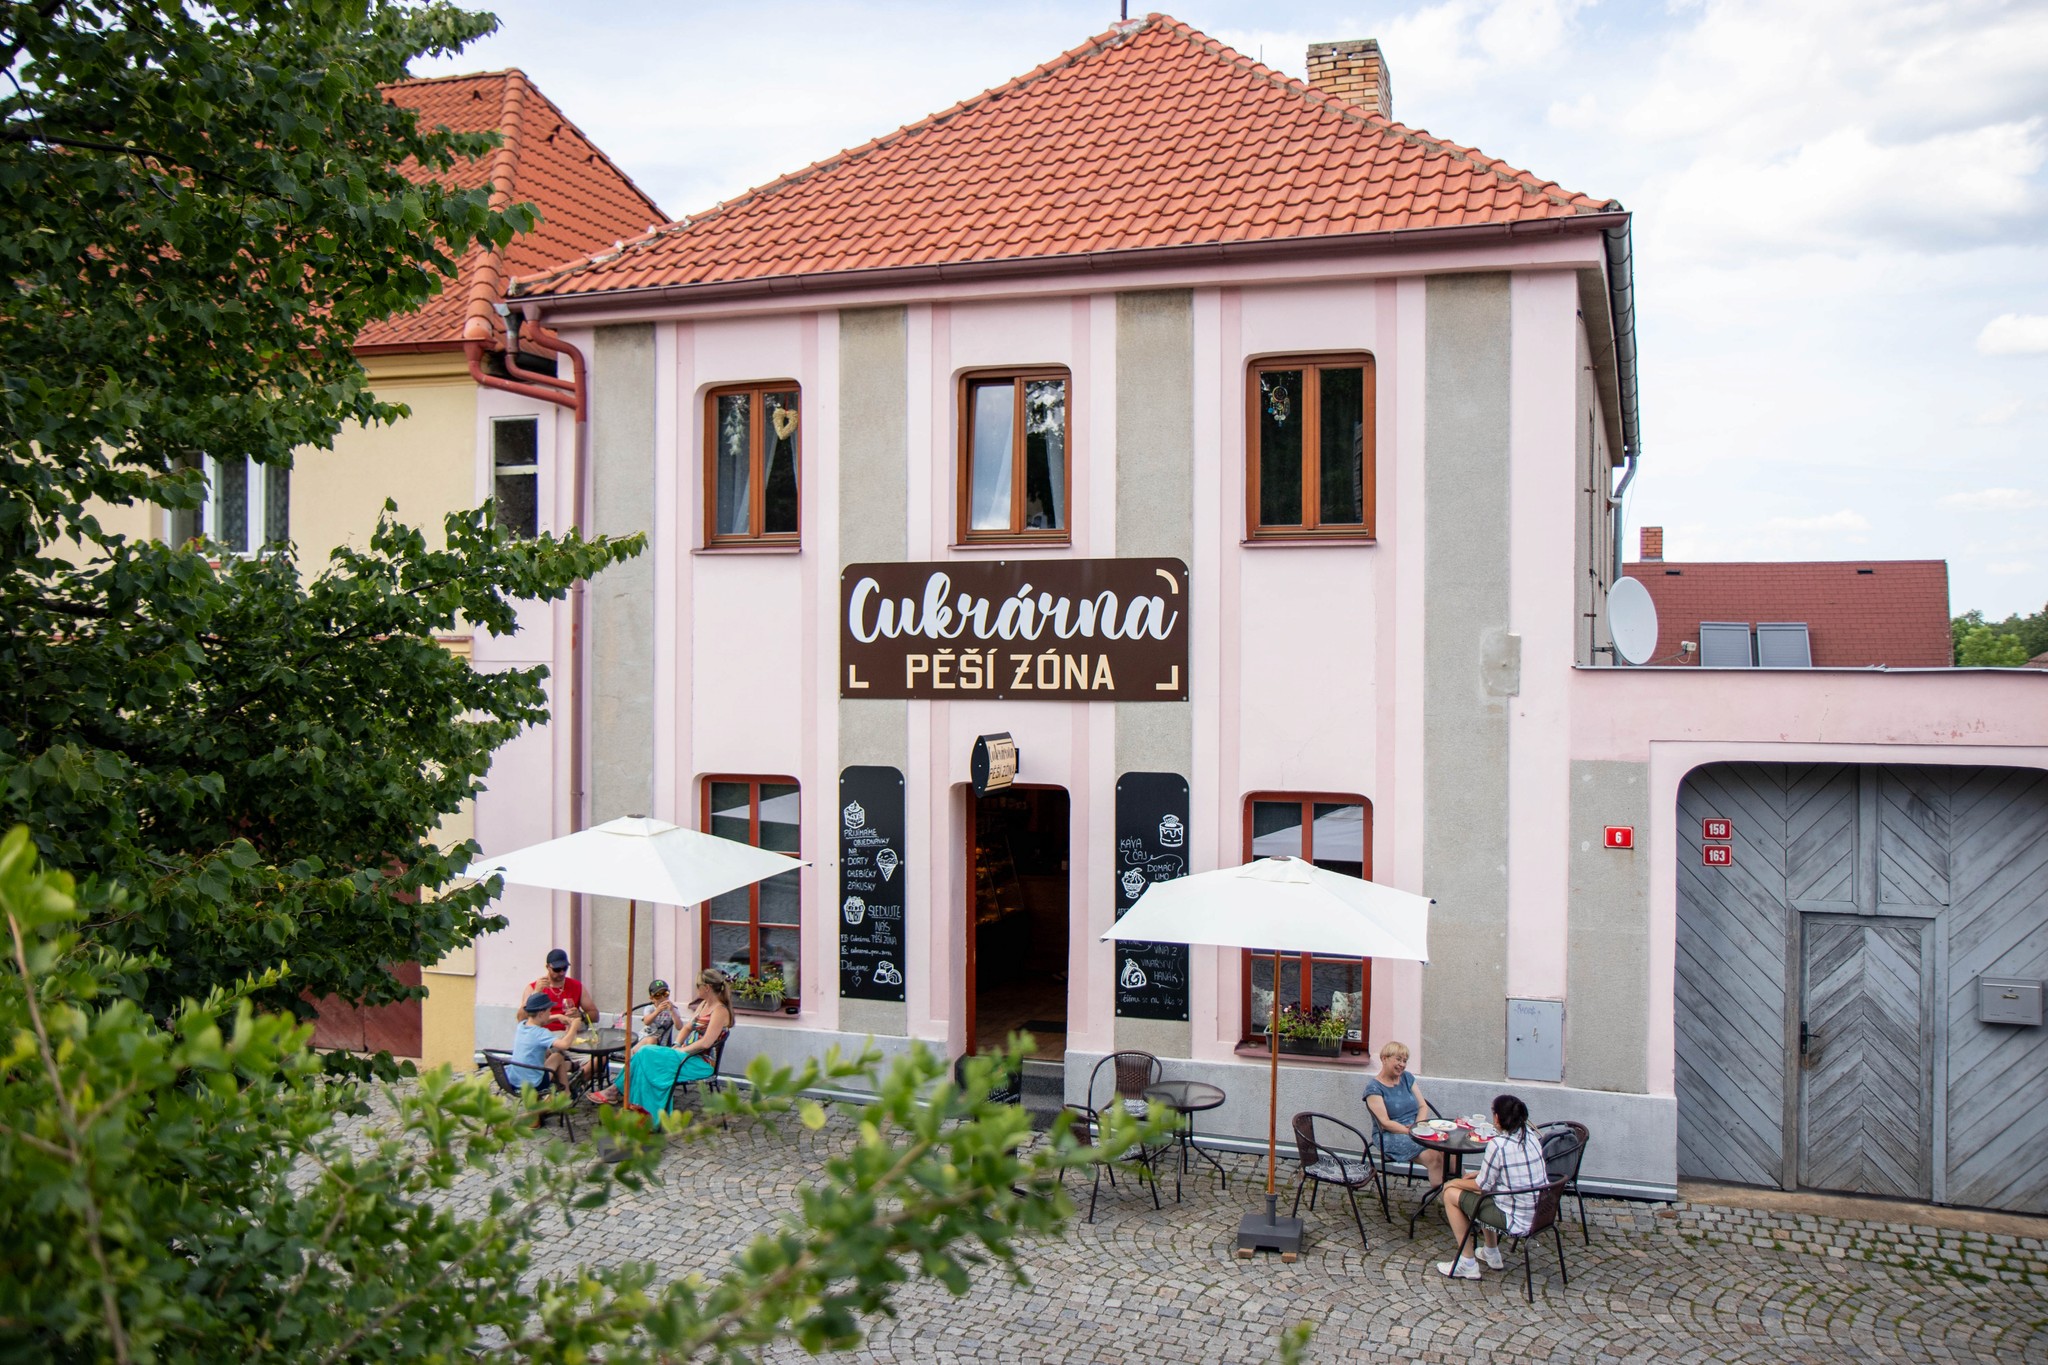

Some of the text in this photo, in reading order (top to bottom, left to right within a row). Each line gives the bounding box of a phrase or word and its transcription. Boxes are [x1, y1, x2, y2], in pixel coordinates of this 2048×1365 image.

[849, 572, 1178, 643] Cukrárna
[906, 648, 1115, 690] PĚŠÍ ZÓNA
[1708, 823, 1726, 836] 158
[1120, 836, 1142, 849] KÁVA
[1615, 831, 1622, 844] 6
[847, 857, 869, 866] DORTY
[1132, 849, 1147, 861] ČAJ
[1708, 849, 1726, 862] 163
[1147, 862, 1176, 873] DOMÁCÍ
[867, 905, 901, 918] SLEDUJTE
